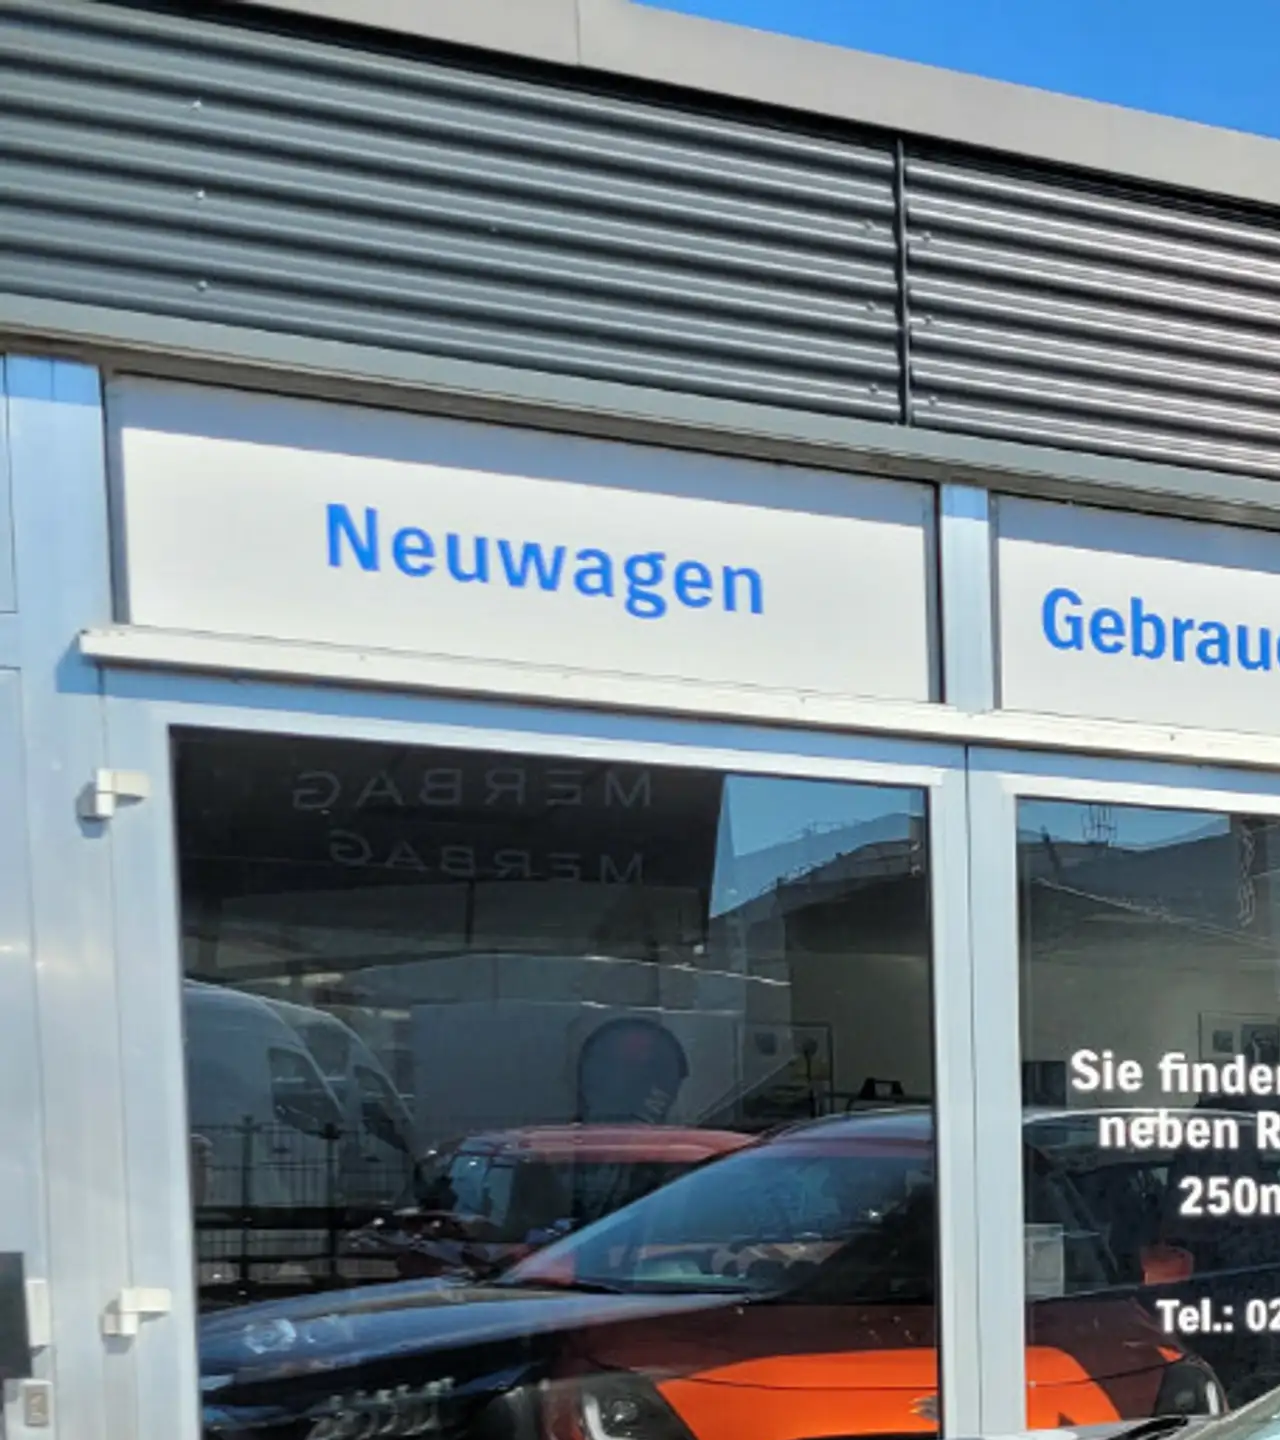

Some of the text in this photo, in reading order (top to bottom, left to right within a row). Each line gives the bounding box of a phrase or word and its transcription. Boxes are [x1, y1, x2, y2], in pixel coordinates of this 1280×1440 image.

[327, 503, 763, 620] Neuwagen
[1070, 1048, 1143, 1092] Sie
[1098, 1107, 1239, 1150] neben
[1155, 1297, 1234, 1334] Tel.:
